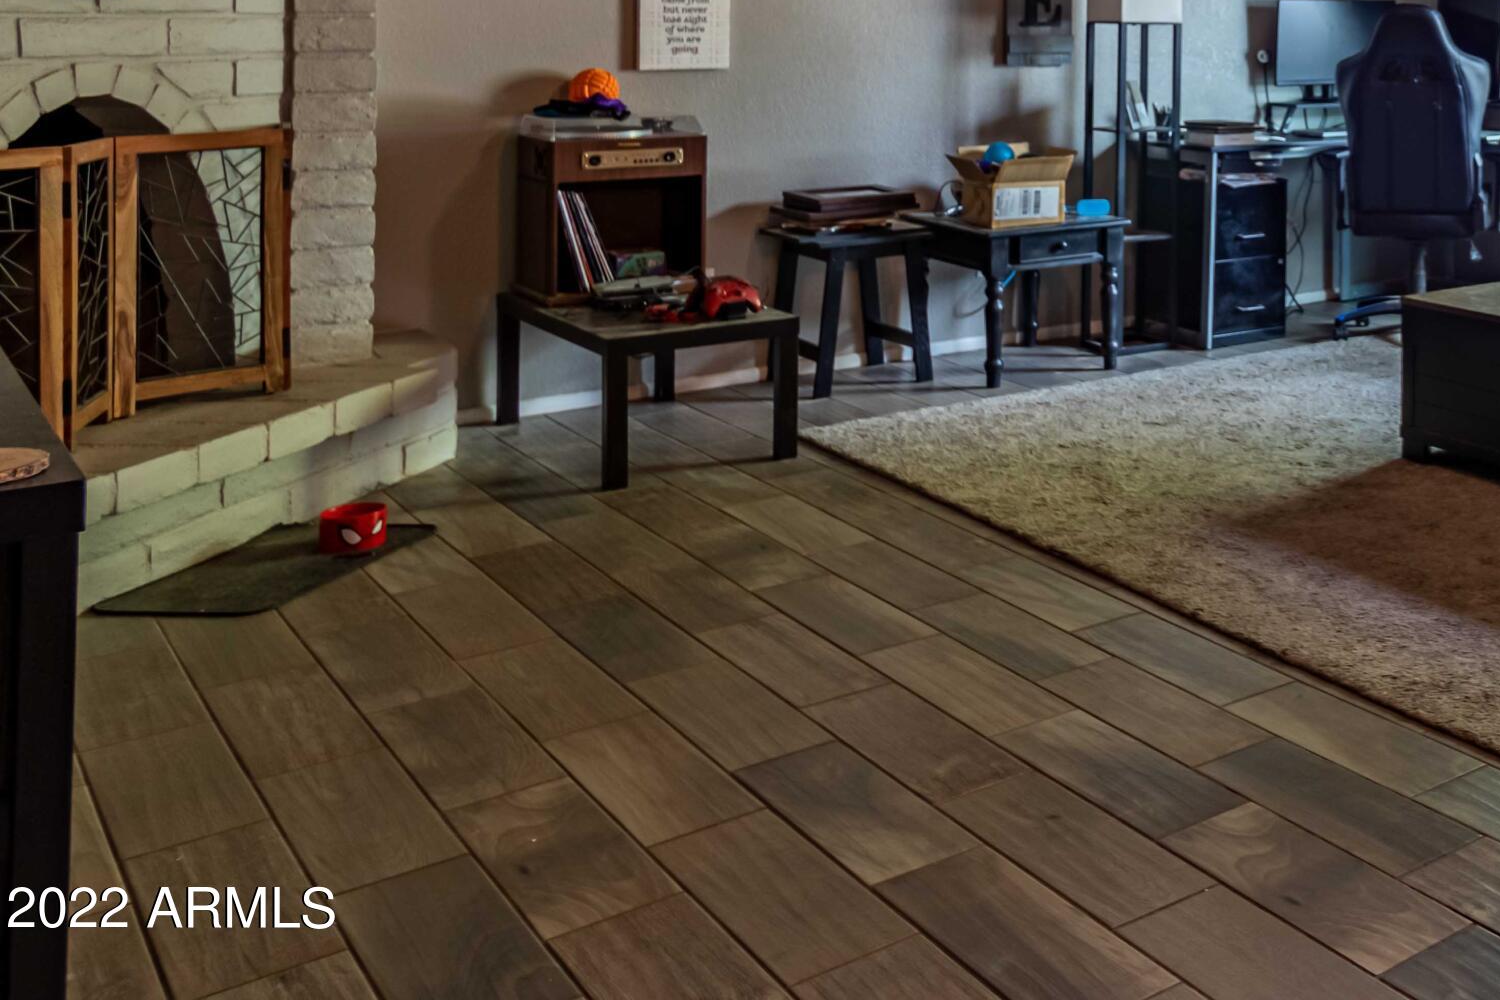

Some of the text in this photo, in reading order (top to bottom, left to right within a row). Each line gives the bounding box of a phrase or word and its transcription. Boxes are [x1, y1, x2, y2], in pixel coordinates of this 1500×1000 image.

[684, 16, 707, 25] sight
[665, 25, 705, 35] of where
[667, 37, 684, 45] you
[671, 46, 698, 56] going
